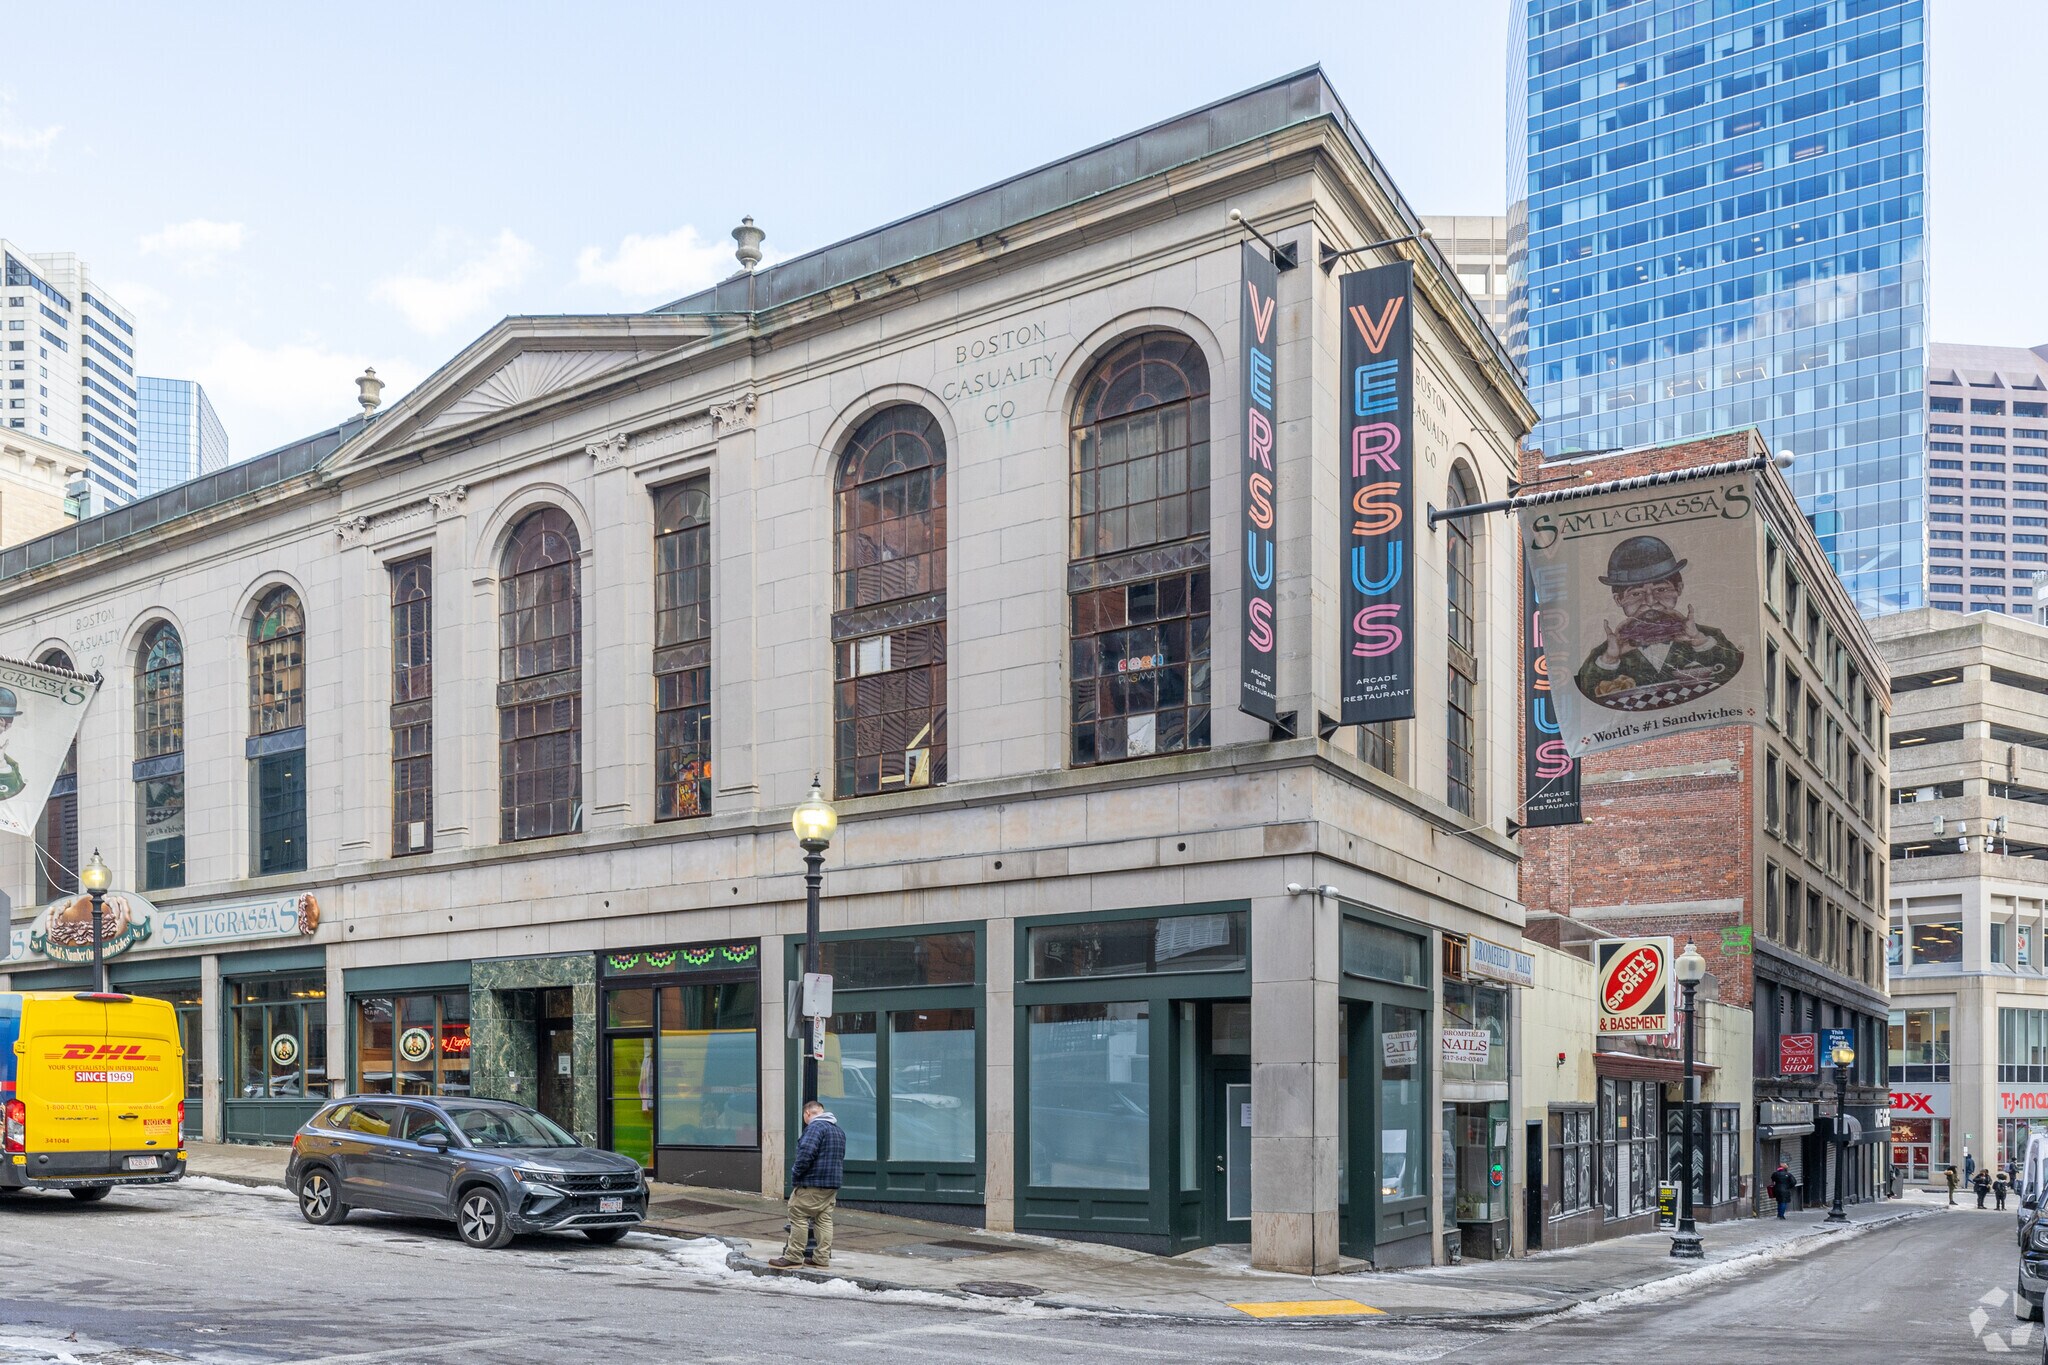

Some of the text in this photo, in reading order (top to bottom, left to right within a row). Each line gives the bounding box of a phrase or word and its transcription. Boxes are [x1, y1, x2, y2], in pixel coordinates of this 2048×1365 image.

[956, 321, 1046, 364] BOSTON
[943, 352, 1057, 400] CASUALTY
[1415, 367, 1447, 418] BOSTON
[985, 401, 1015, 422] CO
[1248, 281, 1275, 652] VERSUS
[1425, 445, 1437, 468] CO
[1349, 296, 1404, 657] VERSUS
[1531, 514, 1594, 550] SAM
[76, 607, 115, 630] BOSTON
[73, 628, 121, 652] CASUALTY
[91, 655, 104, 668] CO
[1250, 668, 1271, 682] ARCADE
[1255, 678, 1266, 688] BAR
[1356, 674, 1398, 685] ARCADE
[0, 668, 86, 706] GRASSA'S
[1343, 689, 1411, 703] RESTAURANT
[1366, 684, 1387, 692] BAR
[1593, 707, 1743, 743] World's #1 Sandwiches
[1528, 802, 1579, 811] RESTAURANT
[163, 912, 199, 944] SAM
[45, 941, 65, 960] World's
[65, 947, 85, 962] Number
[85, 948, 94, 961] On
[102, 934, 130, 958] andwiches
[1475, 940, 1531, 975] BROMFIELD NAILS
[1618, 950, 1647, 983] CITY
[1607, 959, 1656, 1009] SPORTS
[1443, 1030, 1485, 1038] BROMFIELD
[1599, 1016, 1665, 1030] & BASEMENT
[62, 1044, 146, 1061] DHL
[1442, 1038, 1487, 1051] NAILS
[76, 1072, 133, 1082] SINCE 1969
[1782, 1064, 1813, 1072] SHOP
